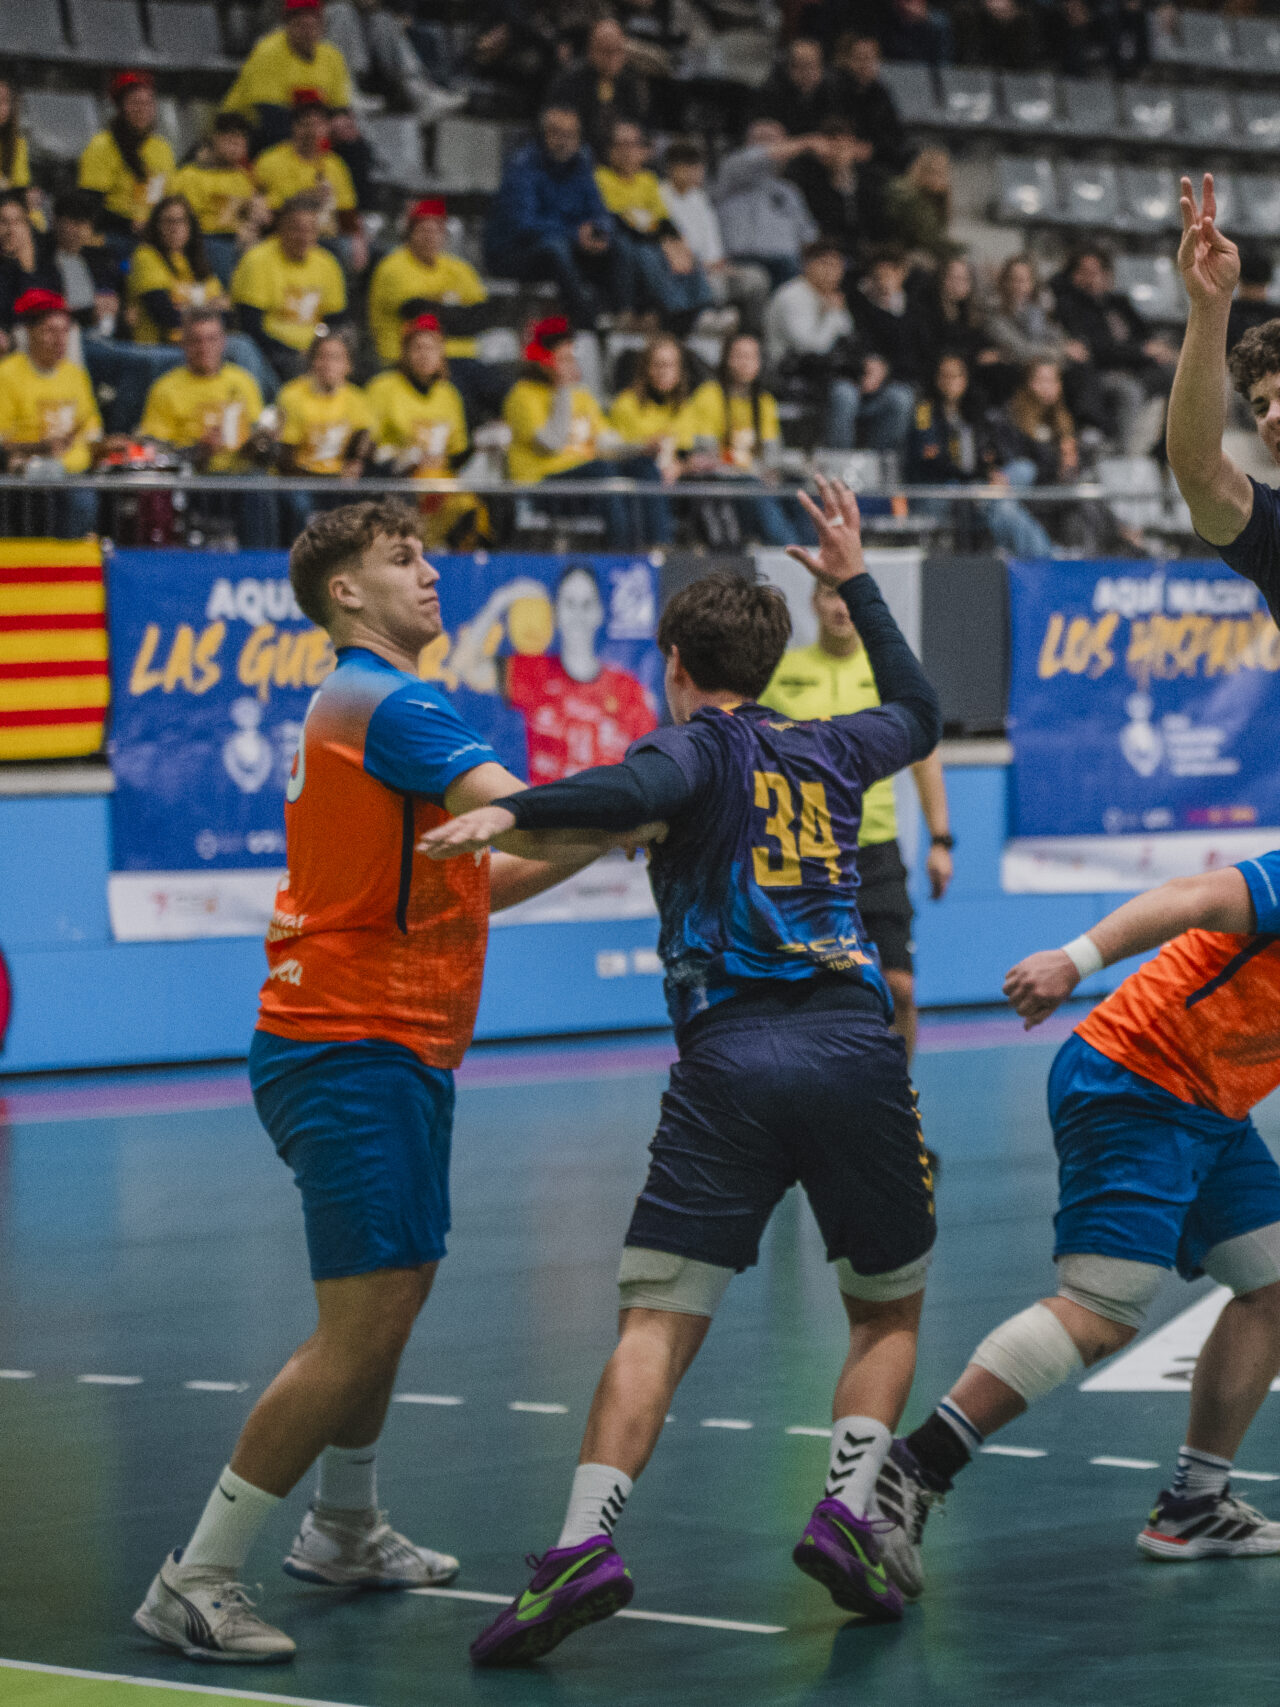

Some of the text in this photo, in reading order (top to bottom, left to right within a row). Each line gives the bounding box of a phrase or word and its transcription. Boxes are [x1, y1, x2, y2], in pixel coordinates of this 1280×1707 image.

[130, 623, 226, 696] LAS
[1037, 612, 1121, 679] LOS
[751, 771, 842, 887] 34
